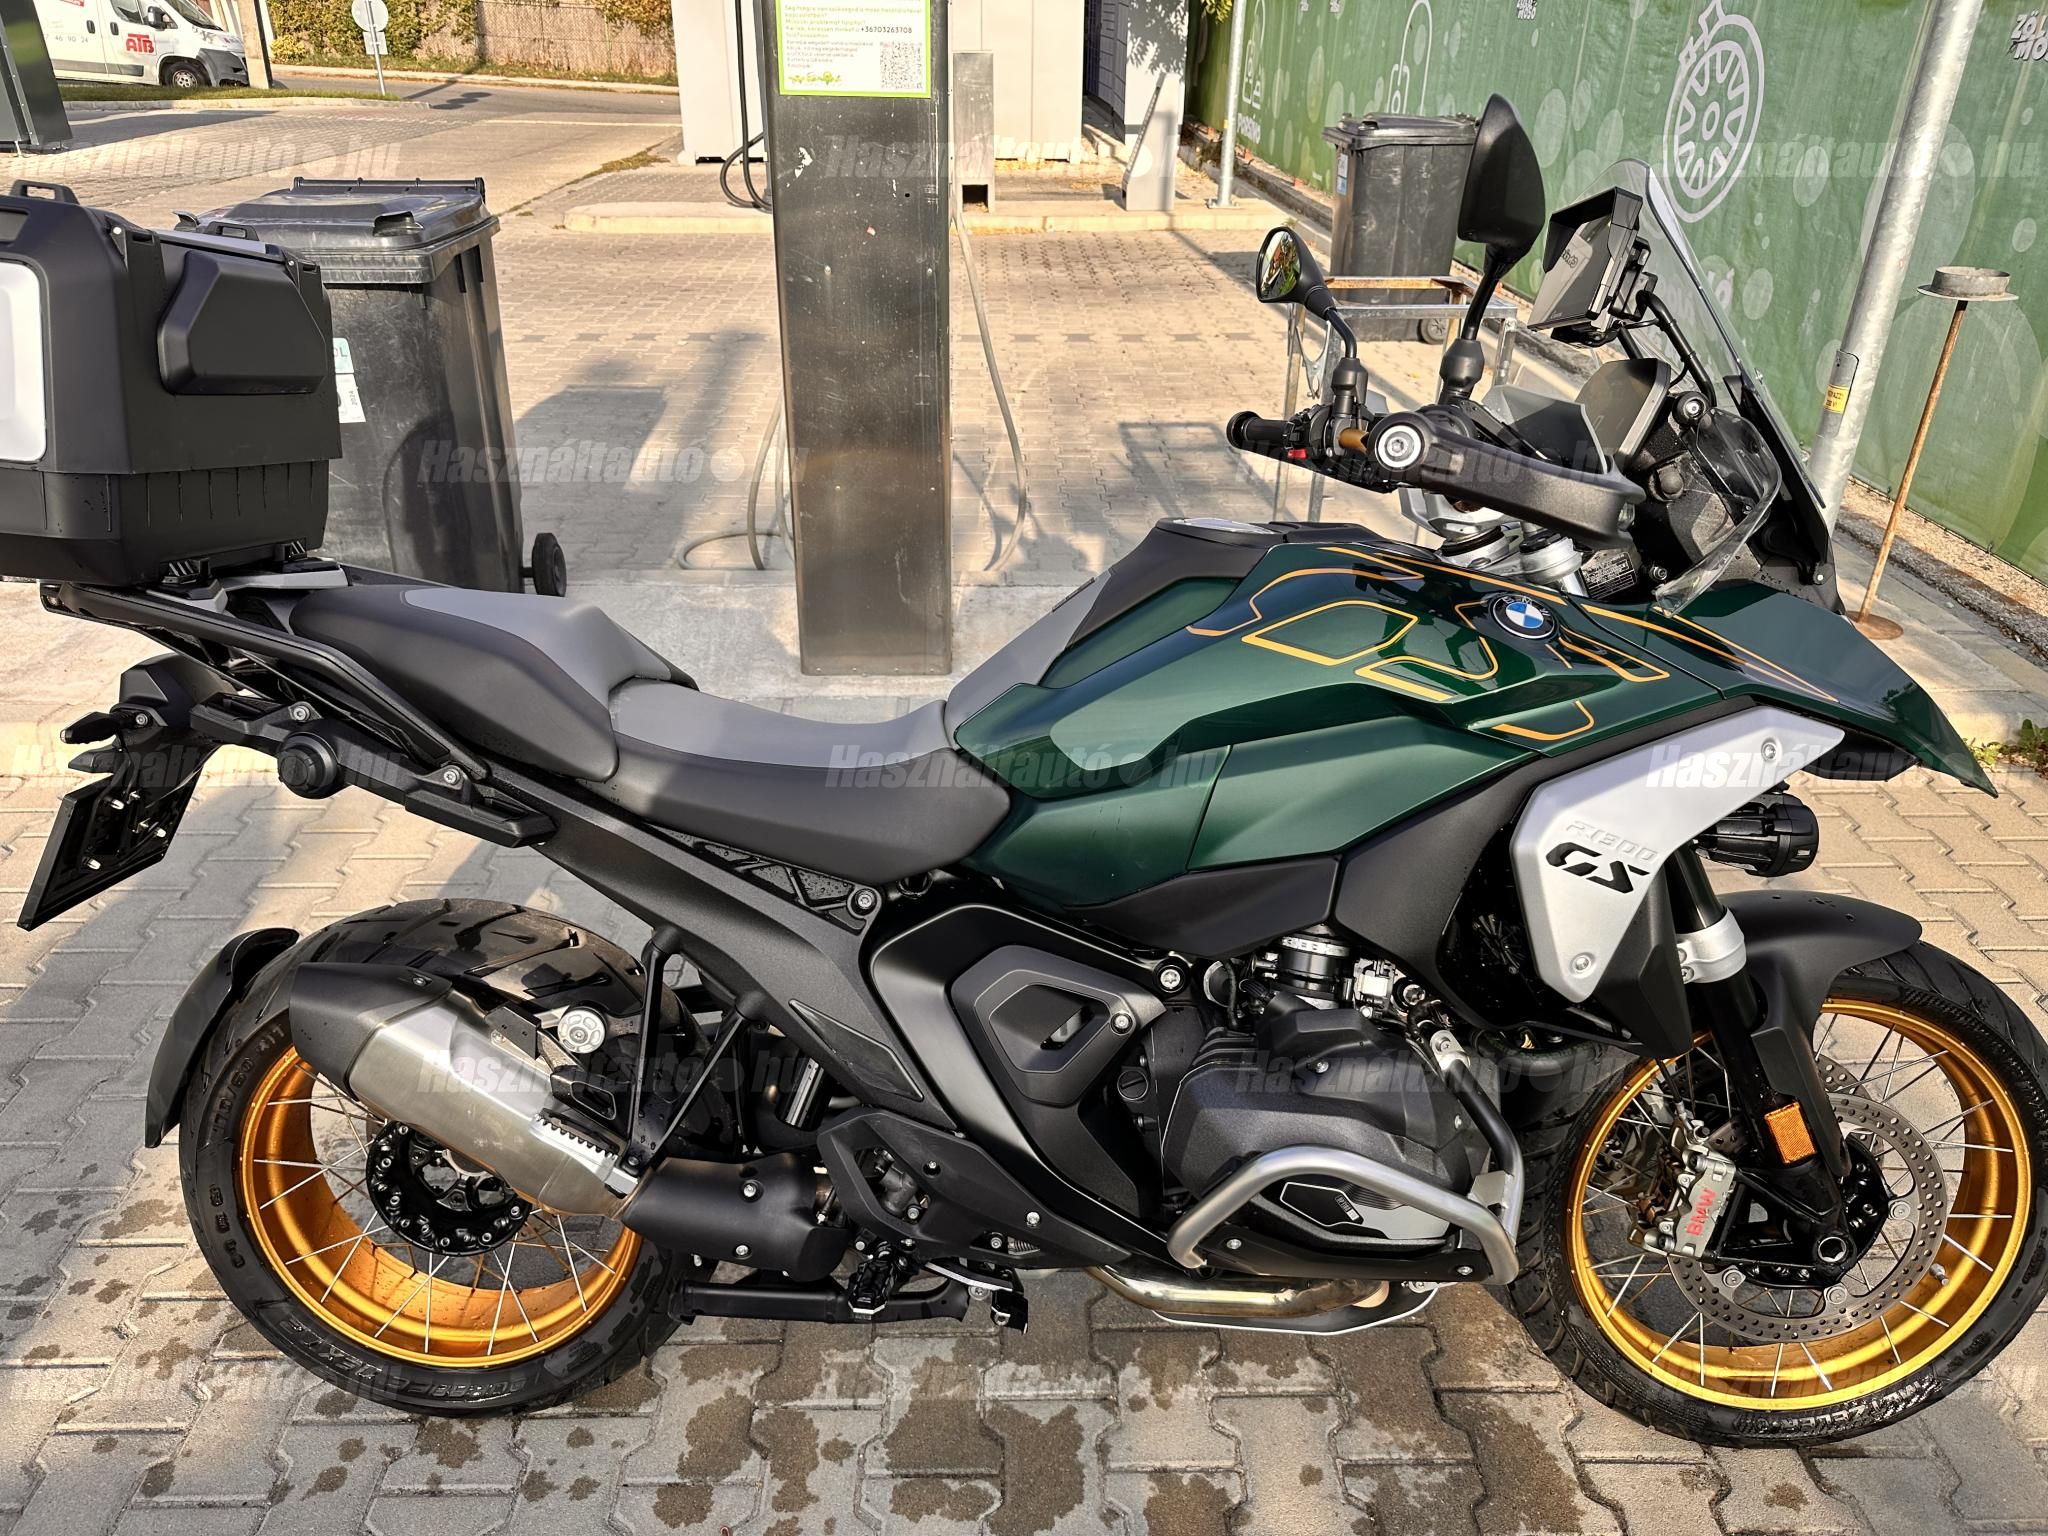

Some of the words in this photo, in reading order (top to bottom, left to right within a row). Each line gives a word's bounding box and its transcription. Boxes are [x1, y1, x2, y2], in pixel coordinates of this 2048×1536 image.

[125, 33, 154, 53] ATB
[1501, 596, 1551, 617] BMW
[1546, 842, 1650, 894] GS
[1686, 1187, 1716, 1236] BMW
